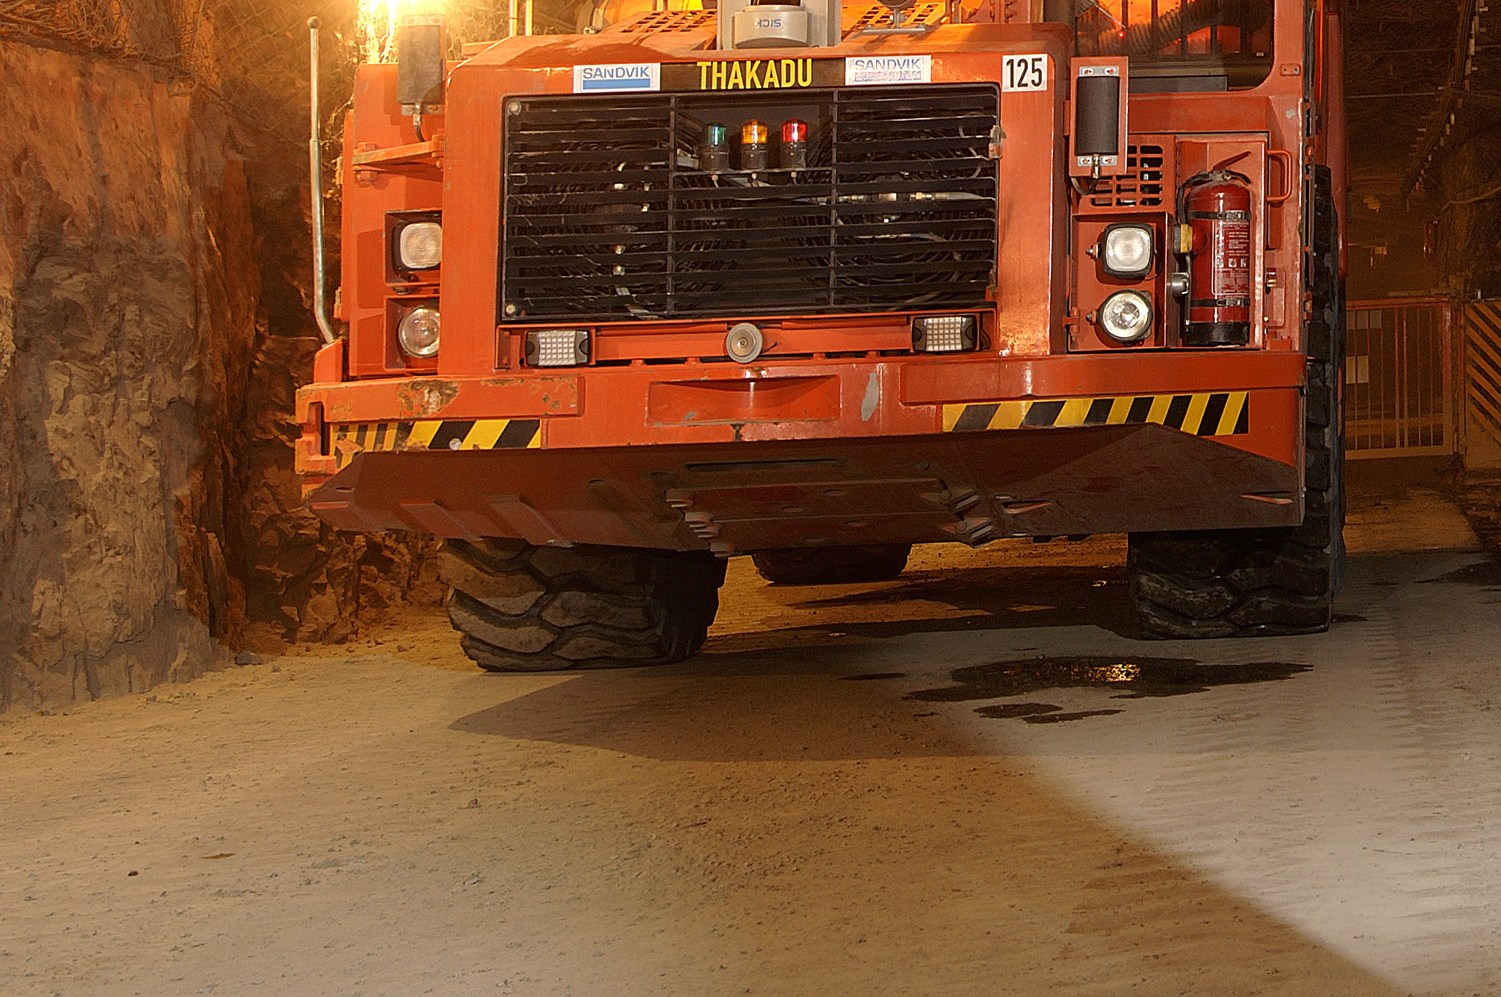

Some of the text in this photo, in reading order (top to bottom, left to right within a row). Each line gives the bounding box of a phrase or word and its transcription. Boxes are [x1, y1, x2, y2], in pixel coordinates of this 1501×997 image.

[756, 18, 782, 28] SICK
[854, 58, 921, 72] SANDVIK
[582, 66, 650, 80] SANDVIK
[696, 58, 813, 90] THAKADU
[1006, 57, 1043, 89] 125
